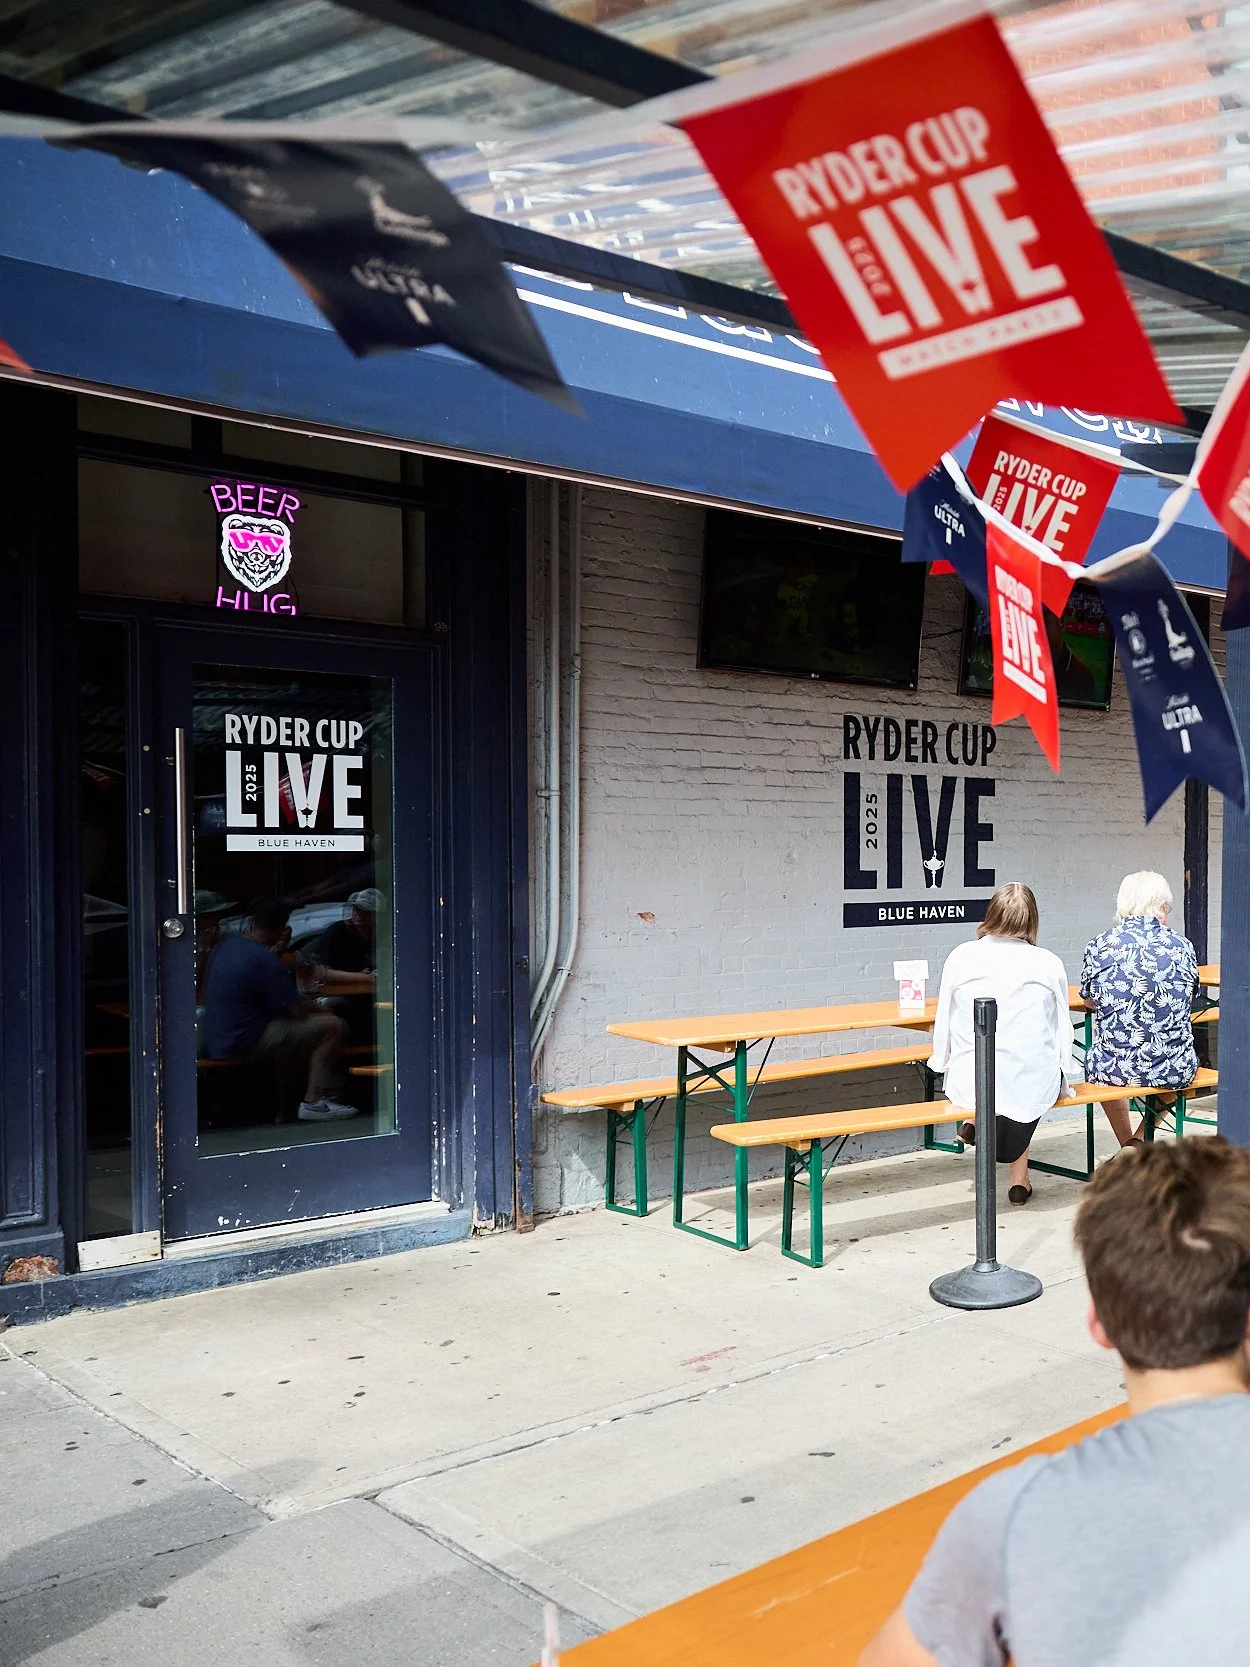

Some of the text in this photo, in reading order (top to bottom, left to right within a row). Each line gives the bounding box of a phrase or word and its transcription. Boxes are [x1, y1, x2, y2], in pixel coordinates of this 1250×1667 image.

[772, 134, 919, 220] RYDER
[906, 106, 989, 177] CUP
[806, 164, 1068, 346] LIVE
[993, 450, 1087, 501] RYDER CUP
[211, 484, 300, 523] BEER
[934, 504, 967, 538] ULTRA
[981, 473, 1080, 552] LIVE
[217, 585, 296, 616] HUG
[998, 593, 1046, 685] LIVE
[225, 714, 364, 749] RYDER CUP
[843, 714, 997, 766] RYDER CUP
[225, 750, 364, 829] LIVE
[245, 764, 257, 802] 2025
[258, 839, 336, 848] BLUE HAVEN
[843, 771, 996, 890] LIVE
[865, 793, 878, 850] 2025
[878, 905, 965, 921] BLUE HAVEN
